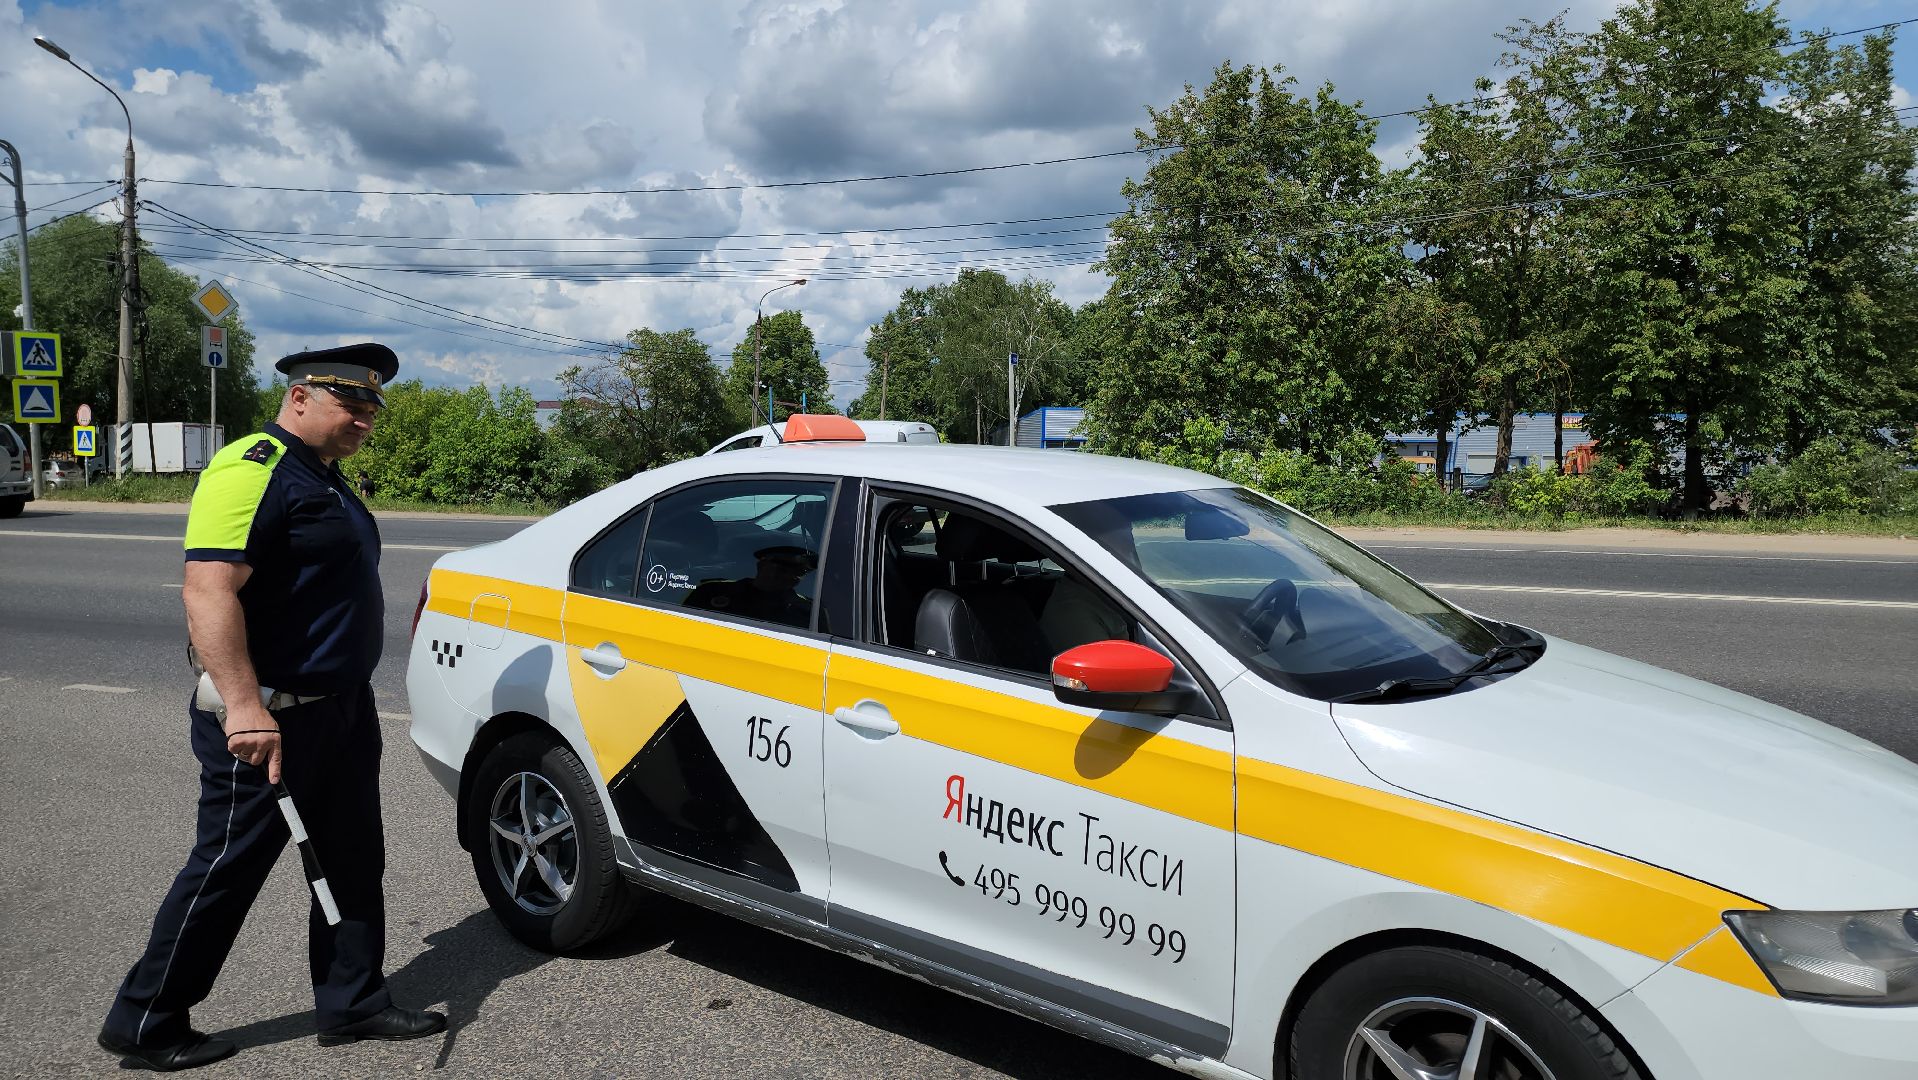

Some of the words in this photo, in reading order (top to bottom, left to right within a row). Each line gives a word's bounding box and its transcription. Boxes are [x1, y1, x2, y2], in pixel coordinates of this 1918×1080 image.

[650, 571, 664, 585] 0+
[746, 715, 792, 768] 156
[942, 774, 1065, 857] Яндекс
[1078, 812, 1184, 897] Такси
[973, 863, 1021, 906] 495
[1034, 883, 1088, 929] 999
[1099, 906, 1136, 946] 99
[1147, 923, 1187, 964] 99
